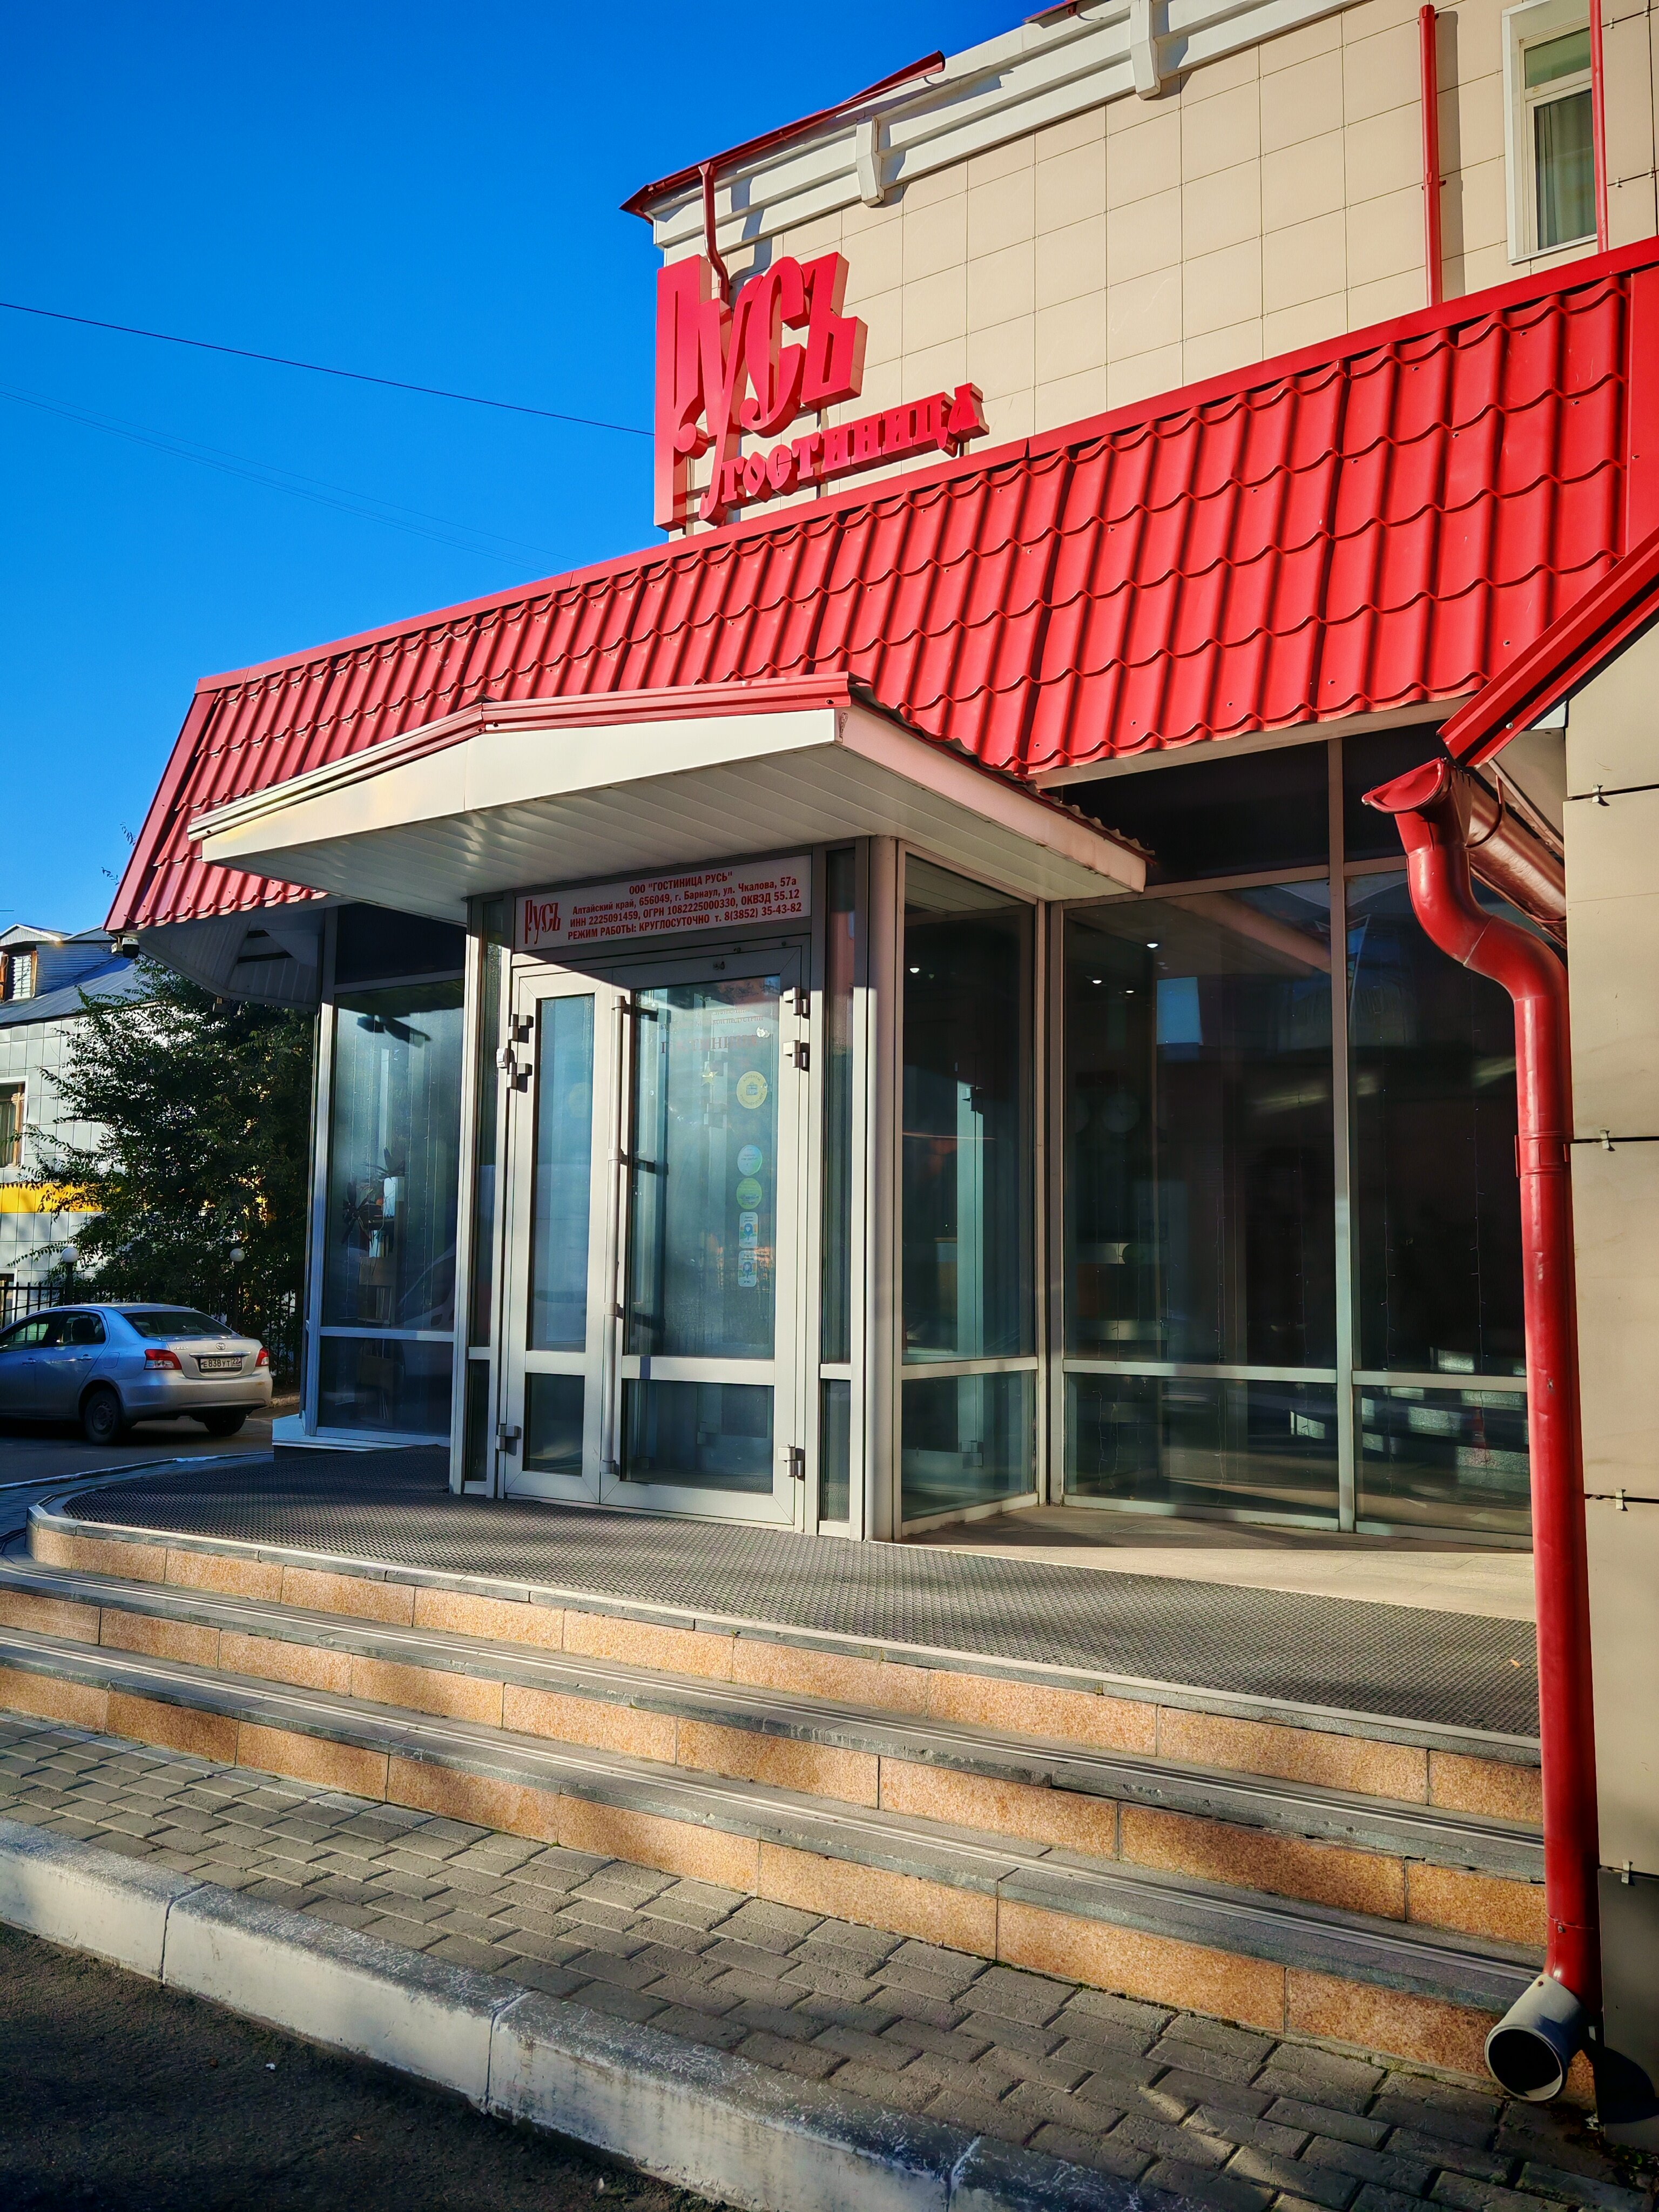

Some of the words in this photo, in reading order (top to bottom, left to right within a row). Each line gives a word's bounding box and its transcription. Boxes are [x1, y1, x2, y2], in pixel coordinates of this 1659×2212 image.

[572, 901, 613, 915] Алтайский
[616, 899, 636, 911] край,
[639, 893, 672, 906] 656049,
[684, 888, 720, 901] Барнаул,
[723, 886, 735, 896] ул.
[738, 881, 777, 892] Чкалова,
[780, 876, 797, 887] 57а
[629, 885, 645, 895] ООО
[649, 875, 702, 891] "ГОСТИНИЦА
[705, 871, 732, 884] РУСЬ"
[568, 928, 598, 940] РЕЖИМ
[600, 923, 637, 936] РАБОТЫ:
[639, 914, 710, 932] КРУГЛОСУТОЧНО
[724, 908, 758, 921] 8(3852)
[761, 902, 802, 916] 35-43-82
[570, 919, 586, 928] ИНН
[588, 911, 640, 925] 2225091459,
[643, 908, 664, 919] ОГРН
[667, 897, 738, 915] 1082225000330,
[741, 893, 771, 905] ОКВЭД
[774, 889, 800, 901] 55.12
